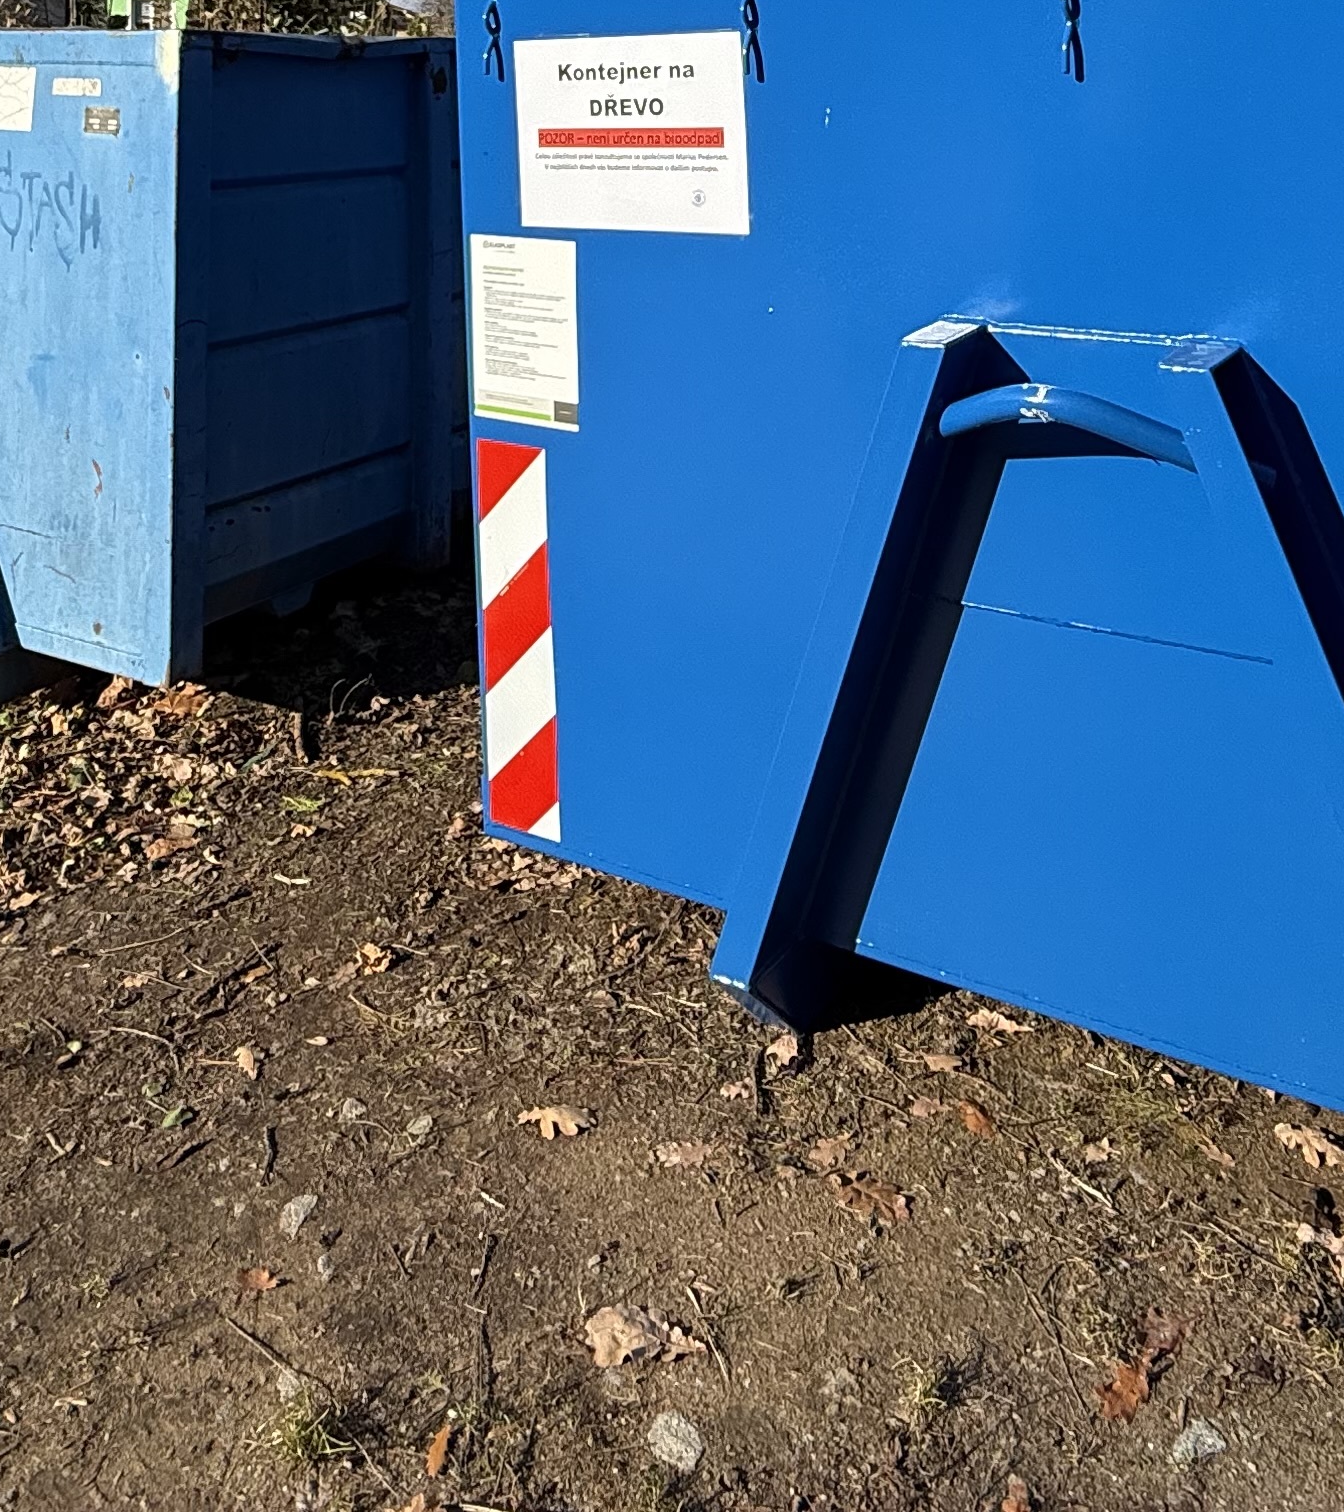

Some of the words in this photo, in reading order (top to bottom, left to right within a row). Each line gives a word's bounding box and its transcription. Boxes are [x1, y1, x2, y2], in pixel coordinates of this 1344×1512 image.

[558, 62, 662, 84] Kontejner
[669, 64, 695, 79] na
[590, 93, 664, 116] DŘEVO
[539, 132, 574, 145] POZOR
[587, 132, 610, 145] není
[613, 131, 644, 145] určen
[647, 134, 661, 145] na
